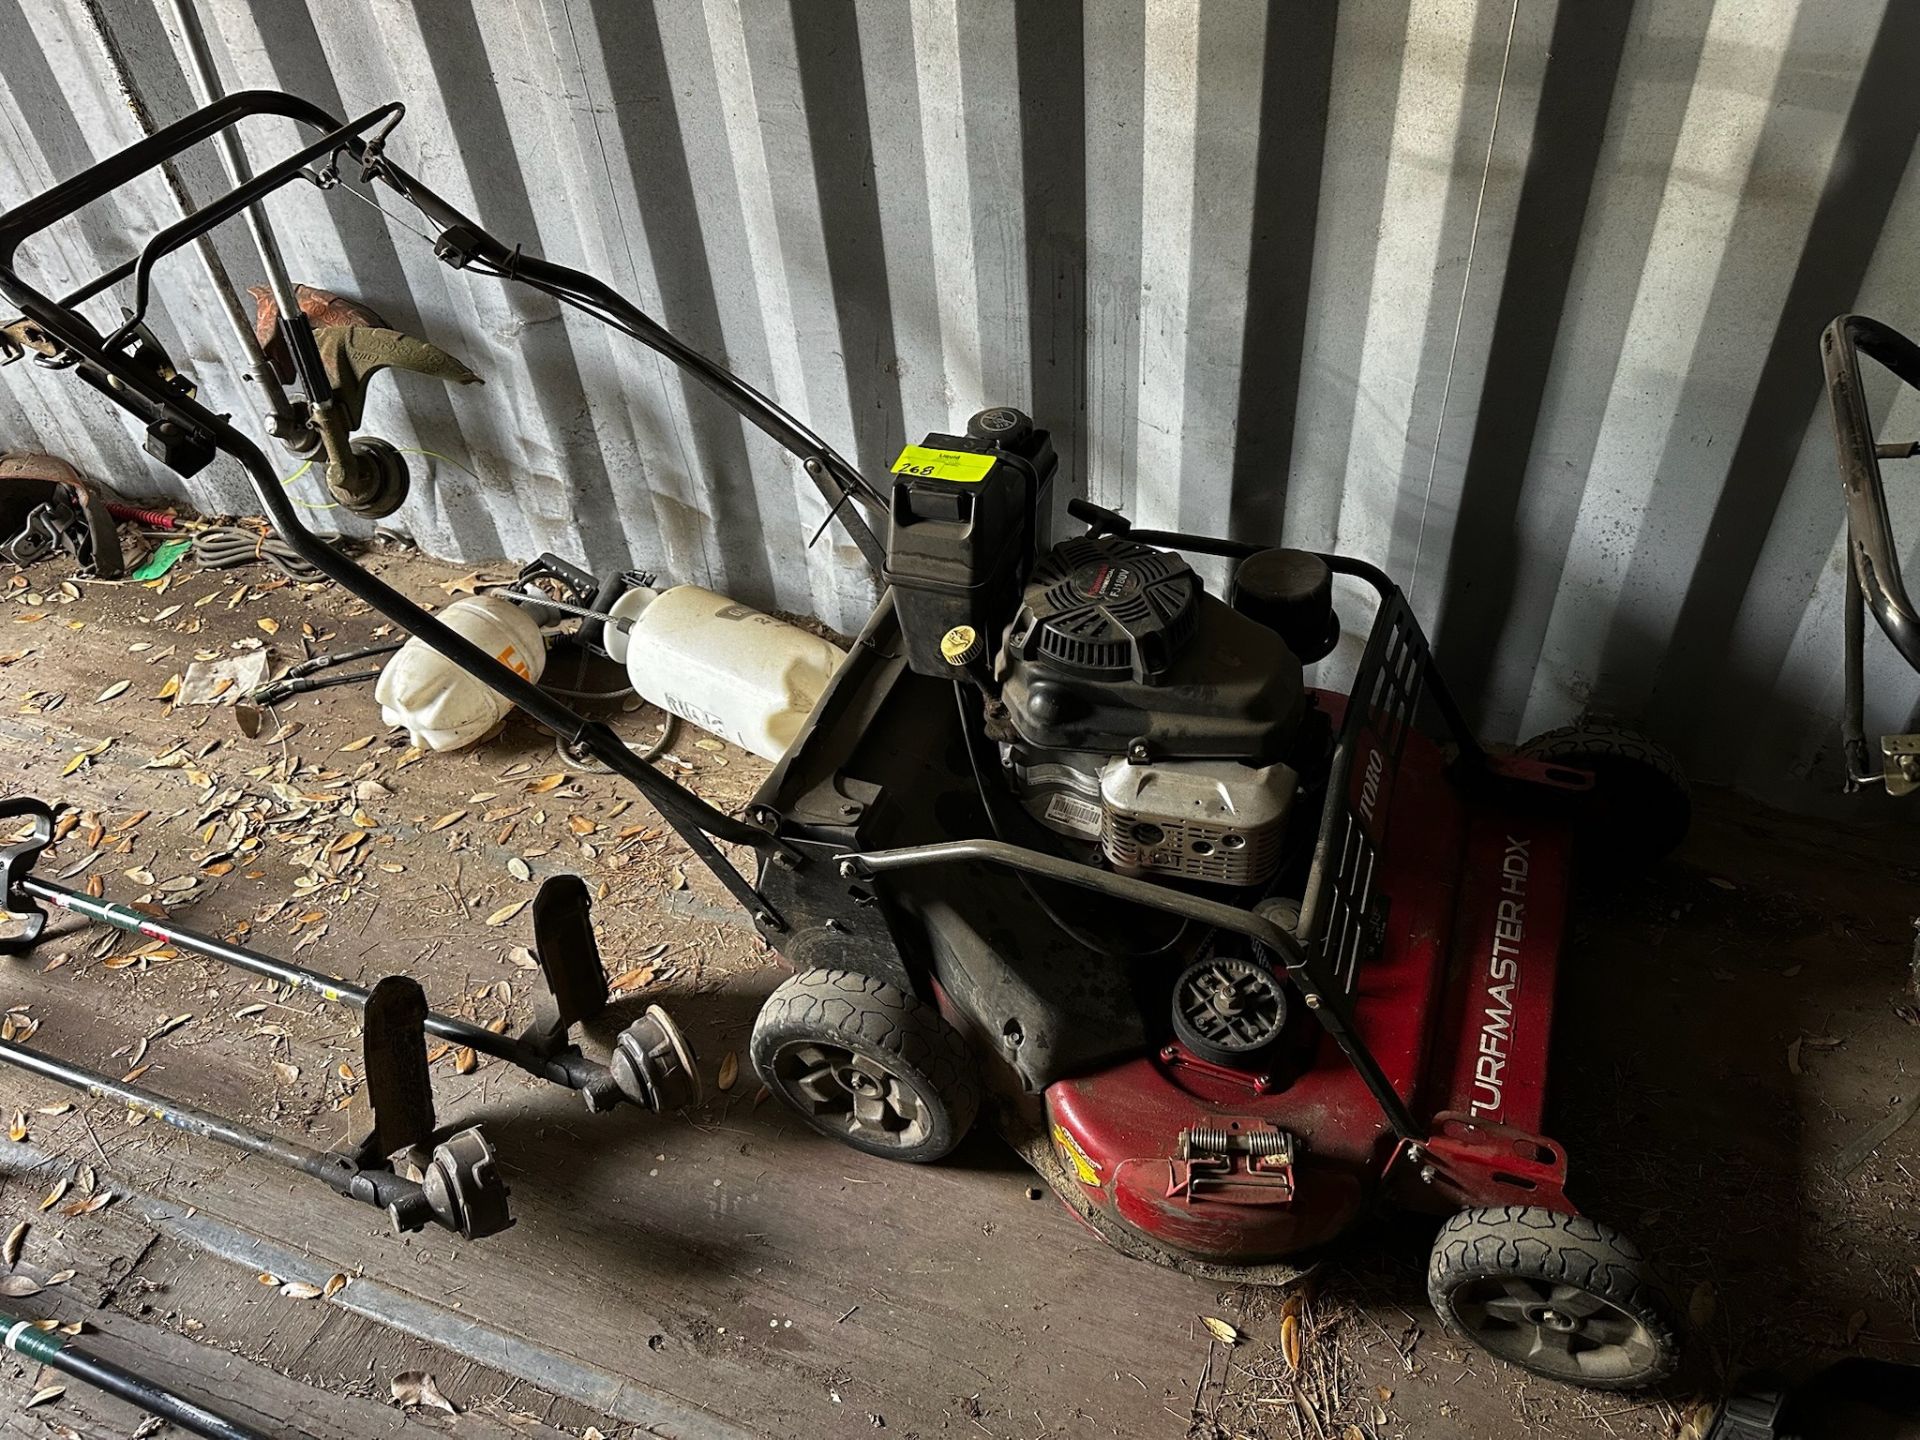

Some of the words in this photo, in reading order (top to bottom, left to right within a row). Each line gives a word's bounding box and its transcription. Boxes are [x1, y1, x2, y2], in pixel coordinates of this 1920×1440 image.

[899, 463, 935, 476] 268
[1109, 568, 1130, 598] FJ180V
[1359, 749, 1383, 823] TORO
[1500, 834, 1532, 897] HDX
